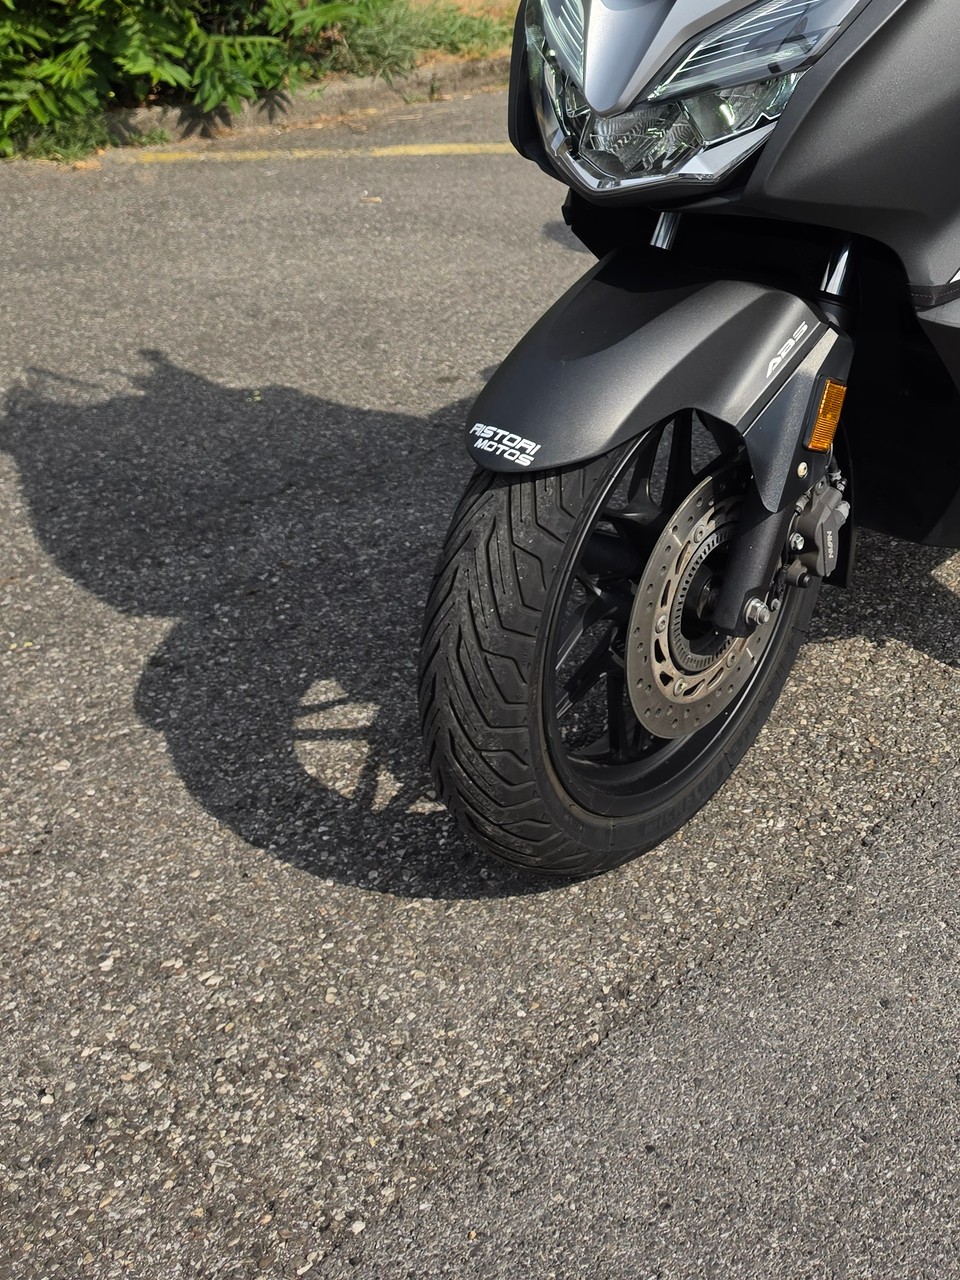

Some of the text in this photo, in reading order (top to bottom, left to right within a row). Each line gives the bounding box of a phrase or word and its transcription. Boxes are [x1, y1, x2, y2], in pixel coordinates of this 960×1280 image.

[765, 320, 809, 379] ABS
[469, 422, 542, 456] RISTORI
[473, 437, 535, 467] MOTOS
